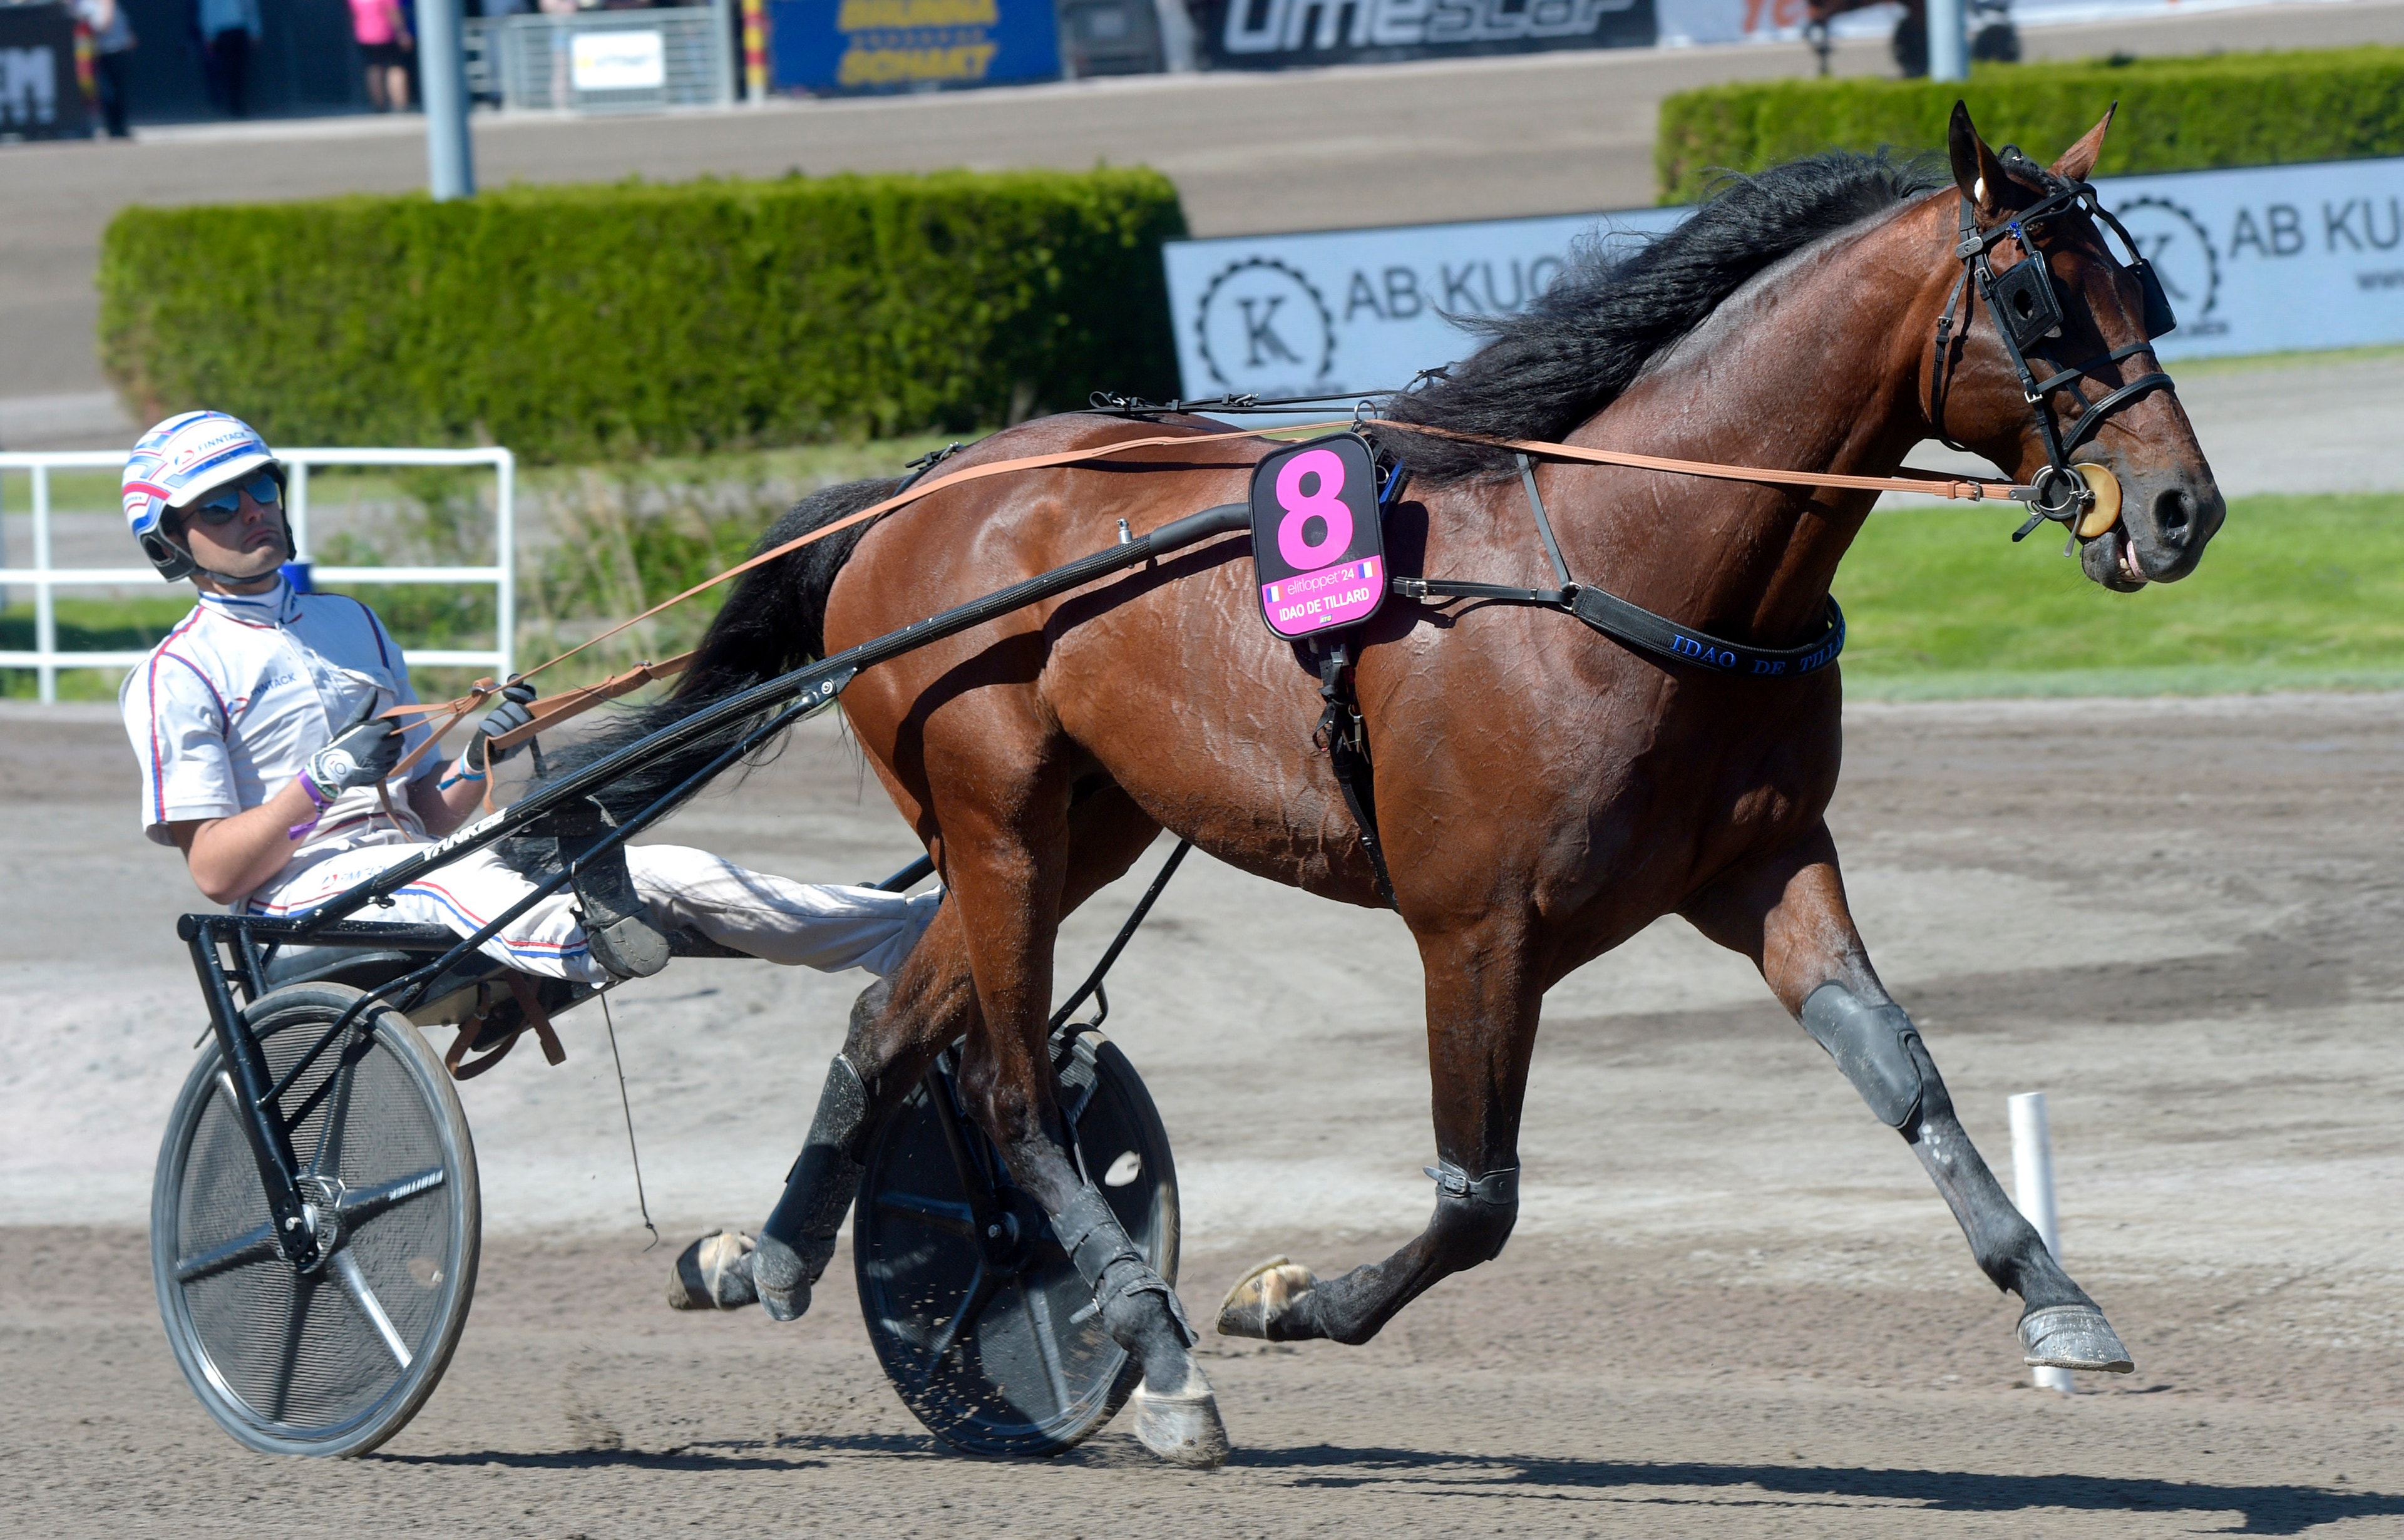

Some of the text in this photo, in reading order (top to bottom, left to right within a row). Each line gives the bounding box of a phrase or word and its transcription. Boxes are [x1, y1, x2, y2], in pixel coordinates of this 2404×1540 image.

[2228, 203, 2305, 259] AB
[1343, 265, 1423, 323] AB
[1235, 294, 1303, 367] K
[198, 431, 245, 452] FINNTACK
[1276, 449, 1354, 570] 8
[1279, 587, 1370, 622] IDAO DE TILLARD
[1287, 572, 1338, 595] elitloppet
[1670, 634, 1737, 668] IDAO
[1750, 659, 1786, 675] DE
[423, 807, 508, 861] YANKEE
